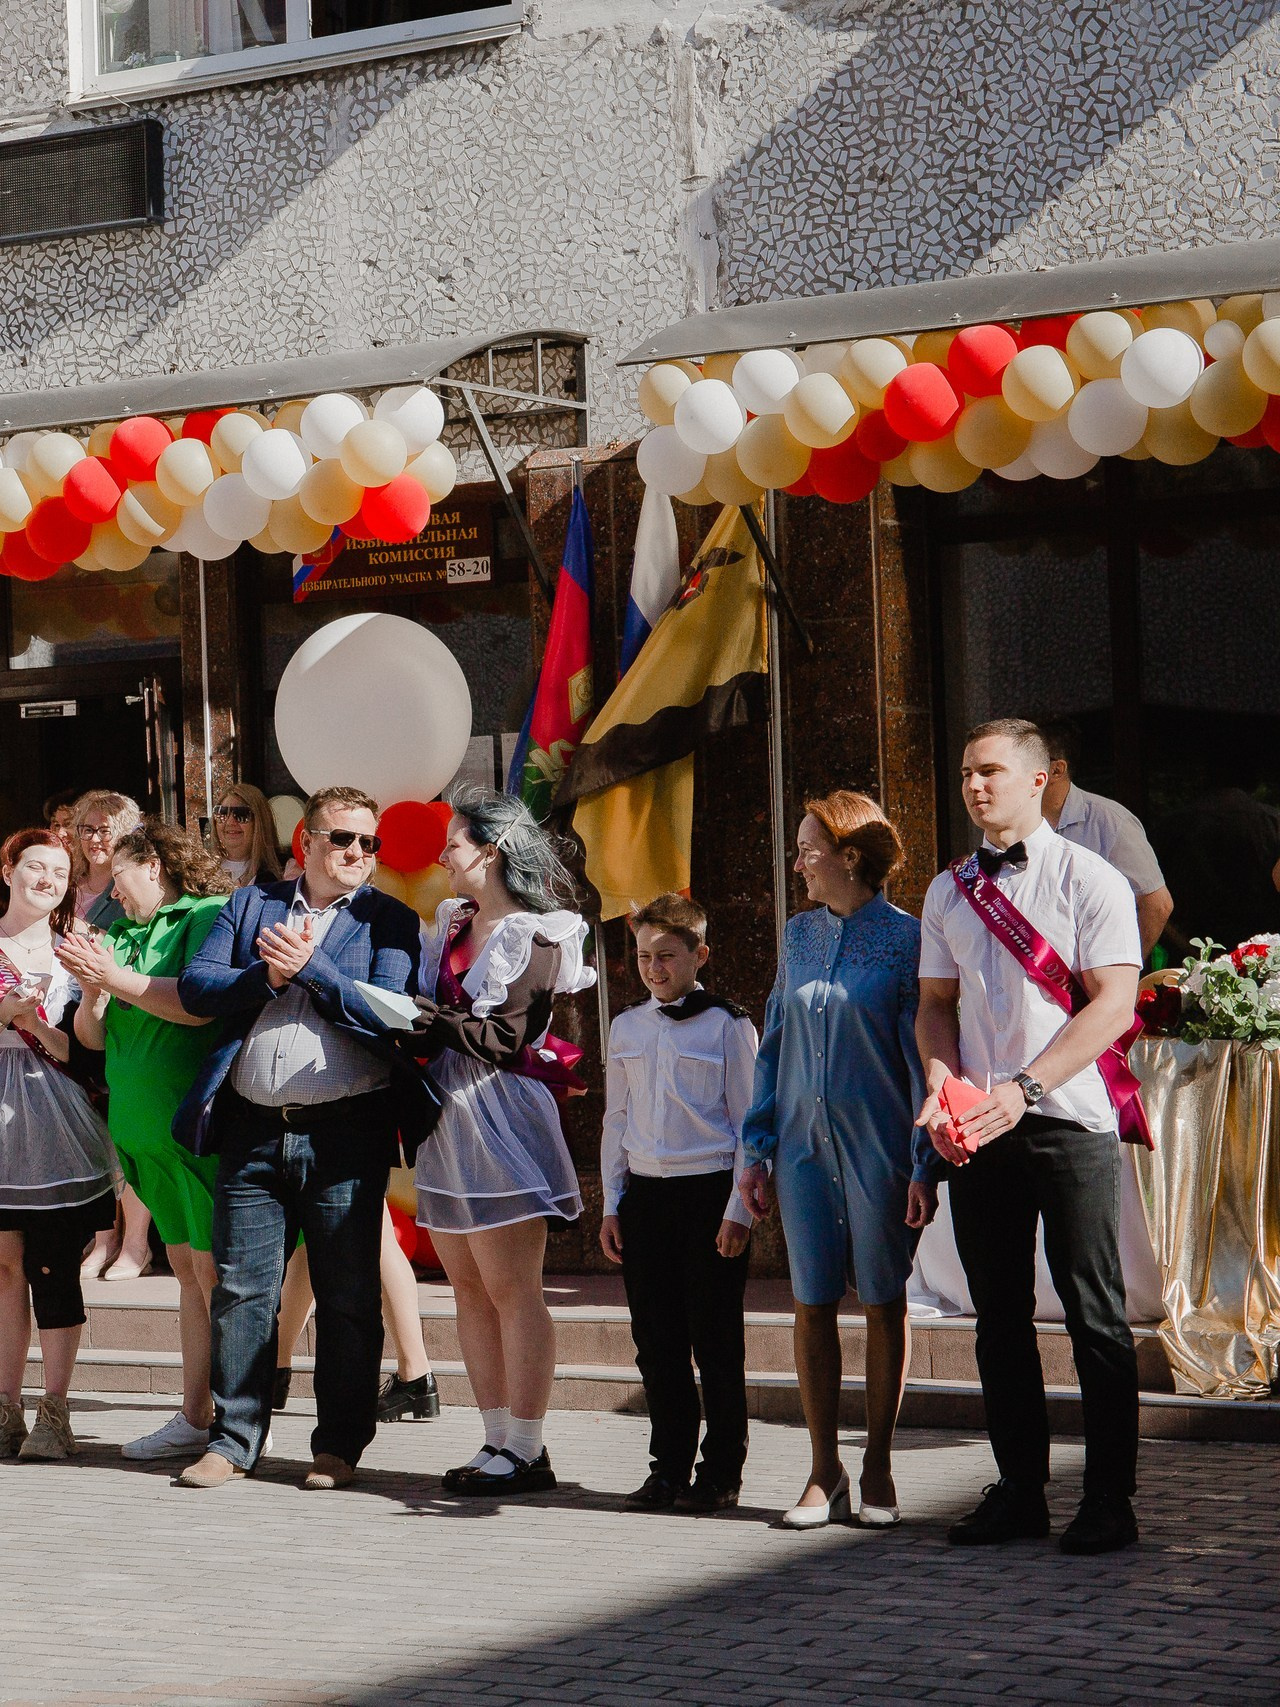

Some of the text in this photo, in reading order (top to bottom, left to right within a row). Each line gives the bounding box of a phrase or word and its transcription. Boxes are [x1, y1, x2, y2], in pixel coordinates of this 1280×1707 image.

[368, 546, 456, 565] КОМИССИЯ
[301, 575, 386, 592] ИЗБИРАТЕЛЬНОГО
[389, 571, 432, 584] УЧАСТКА
[448, 560, 489, 578] 58-20
